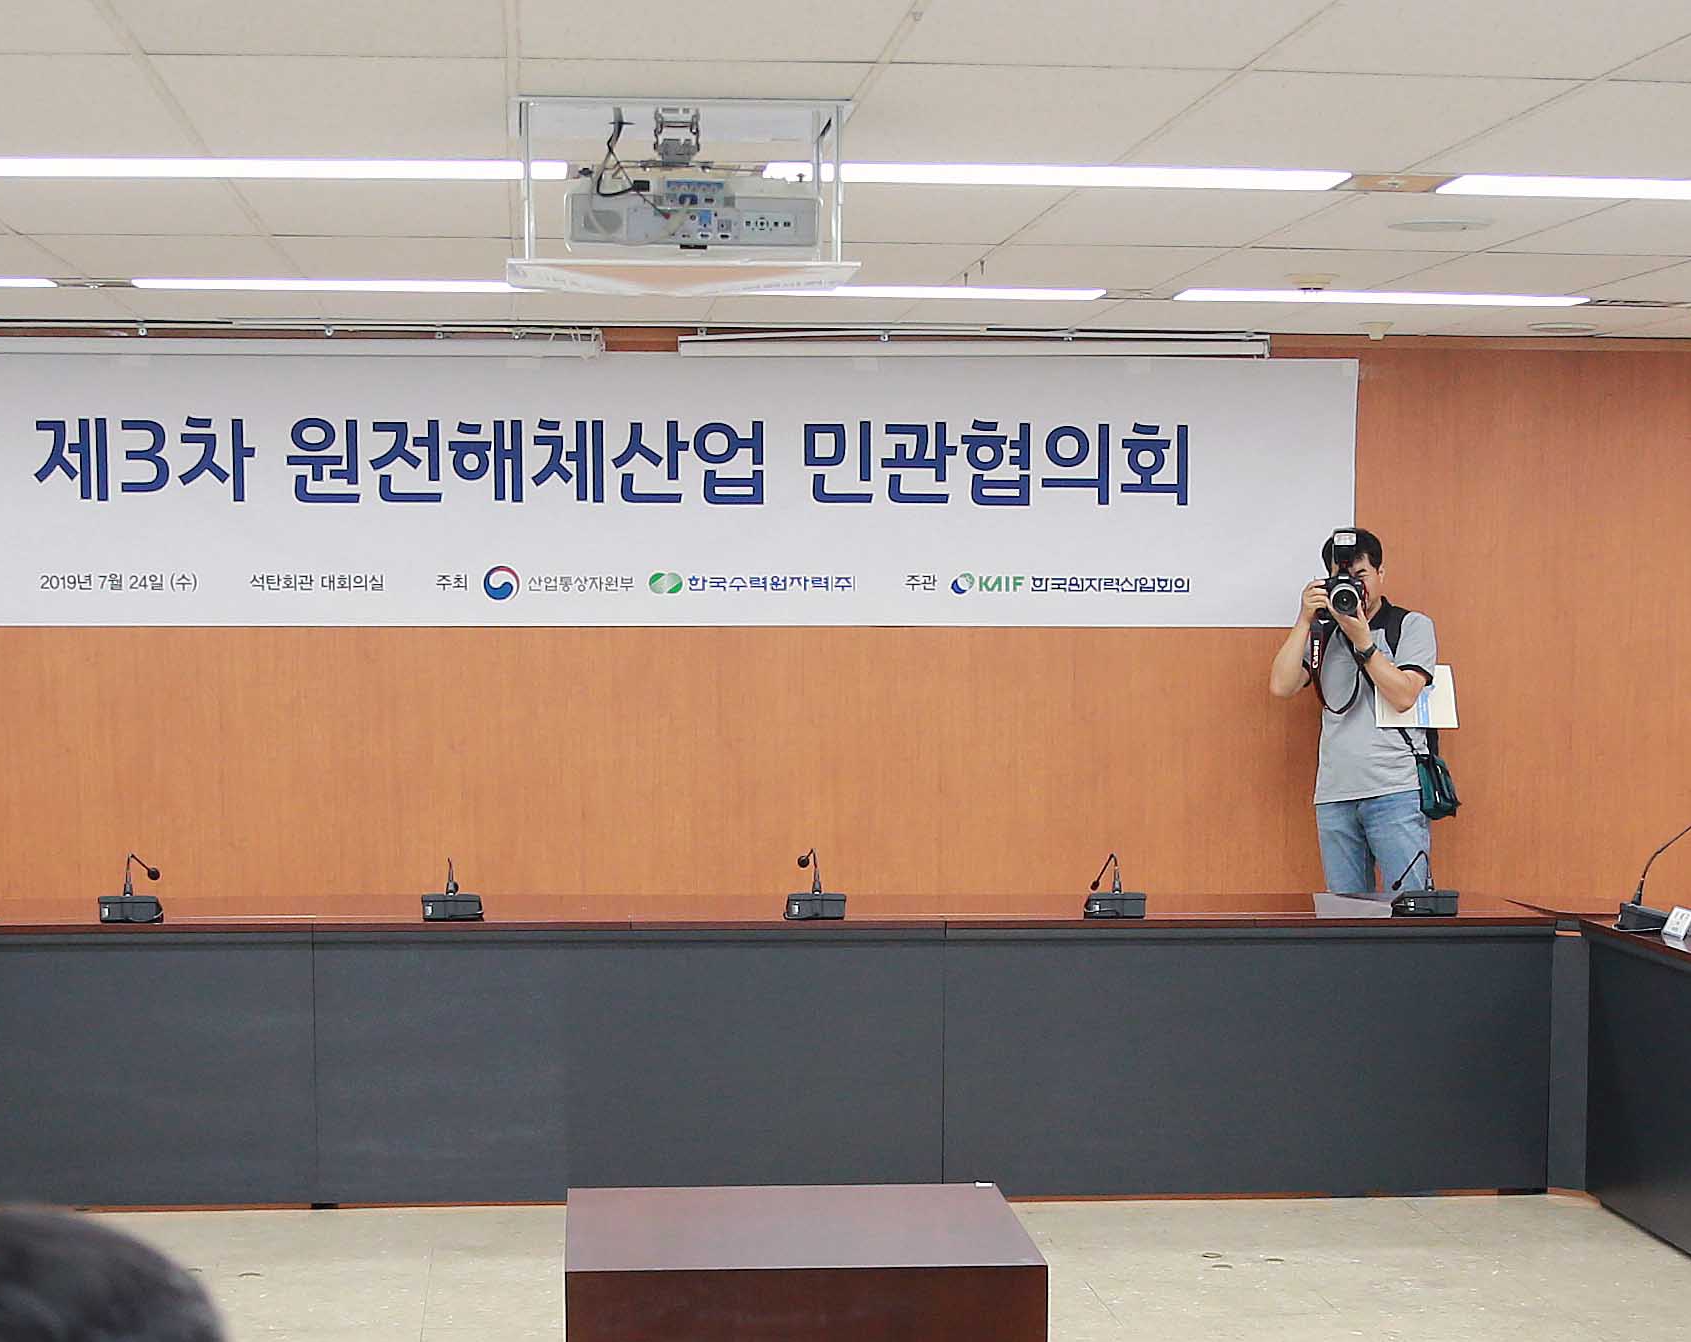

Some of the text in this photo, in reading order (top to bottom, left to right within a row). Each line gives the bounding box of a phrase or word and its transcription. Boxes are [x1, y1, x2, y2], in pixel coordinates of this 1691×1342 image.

[34, 417, 1191, 507] 제3차 원전해체산업 민관협의회
[39, 573, 199, 594] 2019년 7월 24일 (수)
[249, 573, 385, 593] 석탄회관 대회의실
[435, 573, 469, 593] 주최
[527, 574, 634, 594] 산업통상자원부
[905, 574, 938, 593] 주관
[1030, 575, 1191, 595] 한국원자력산업회의
